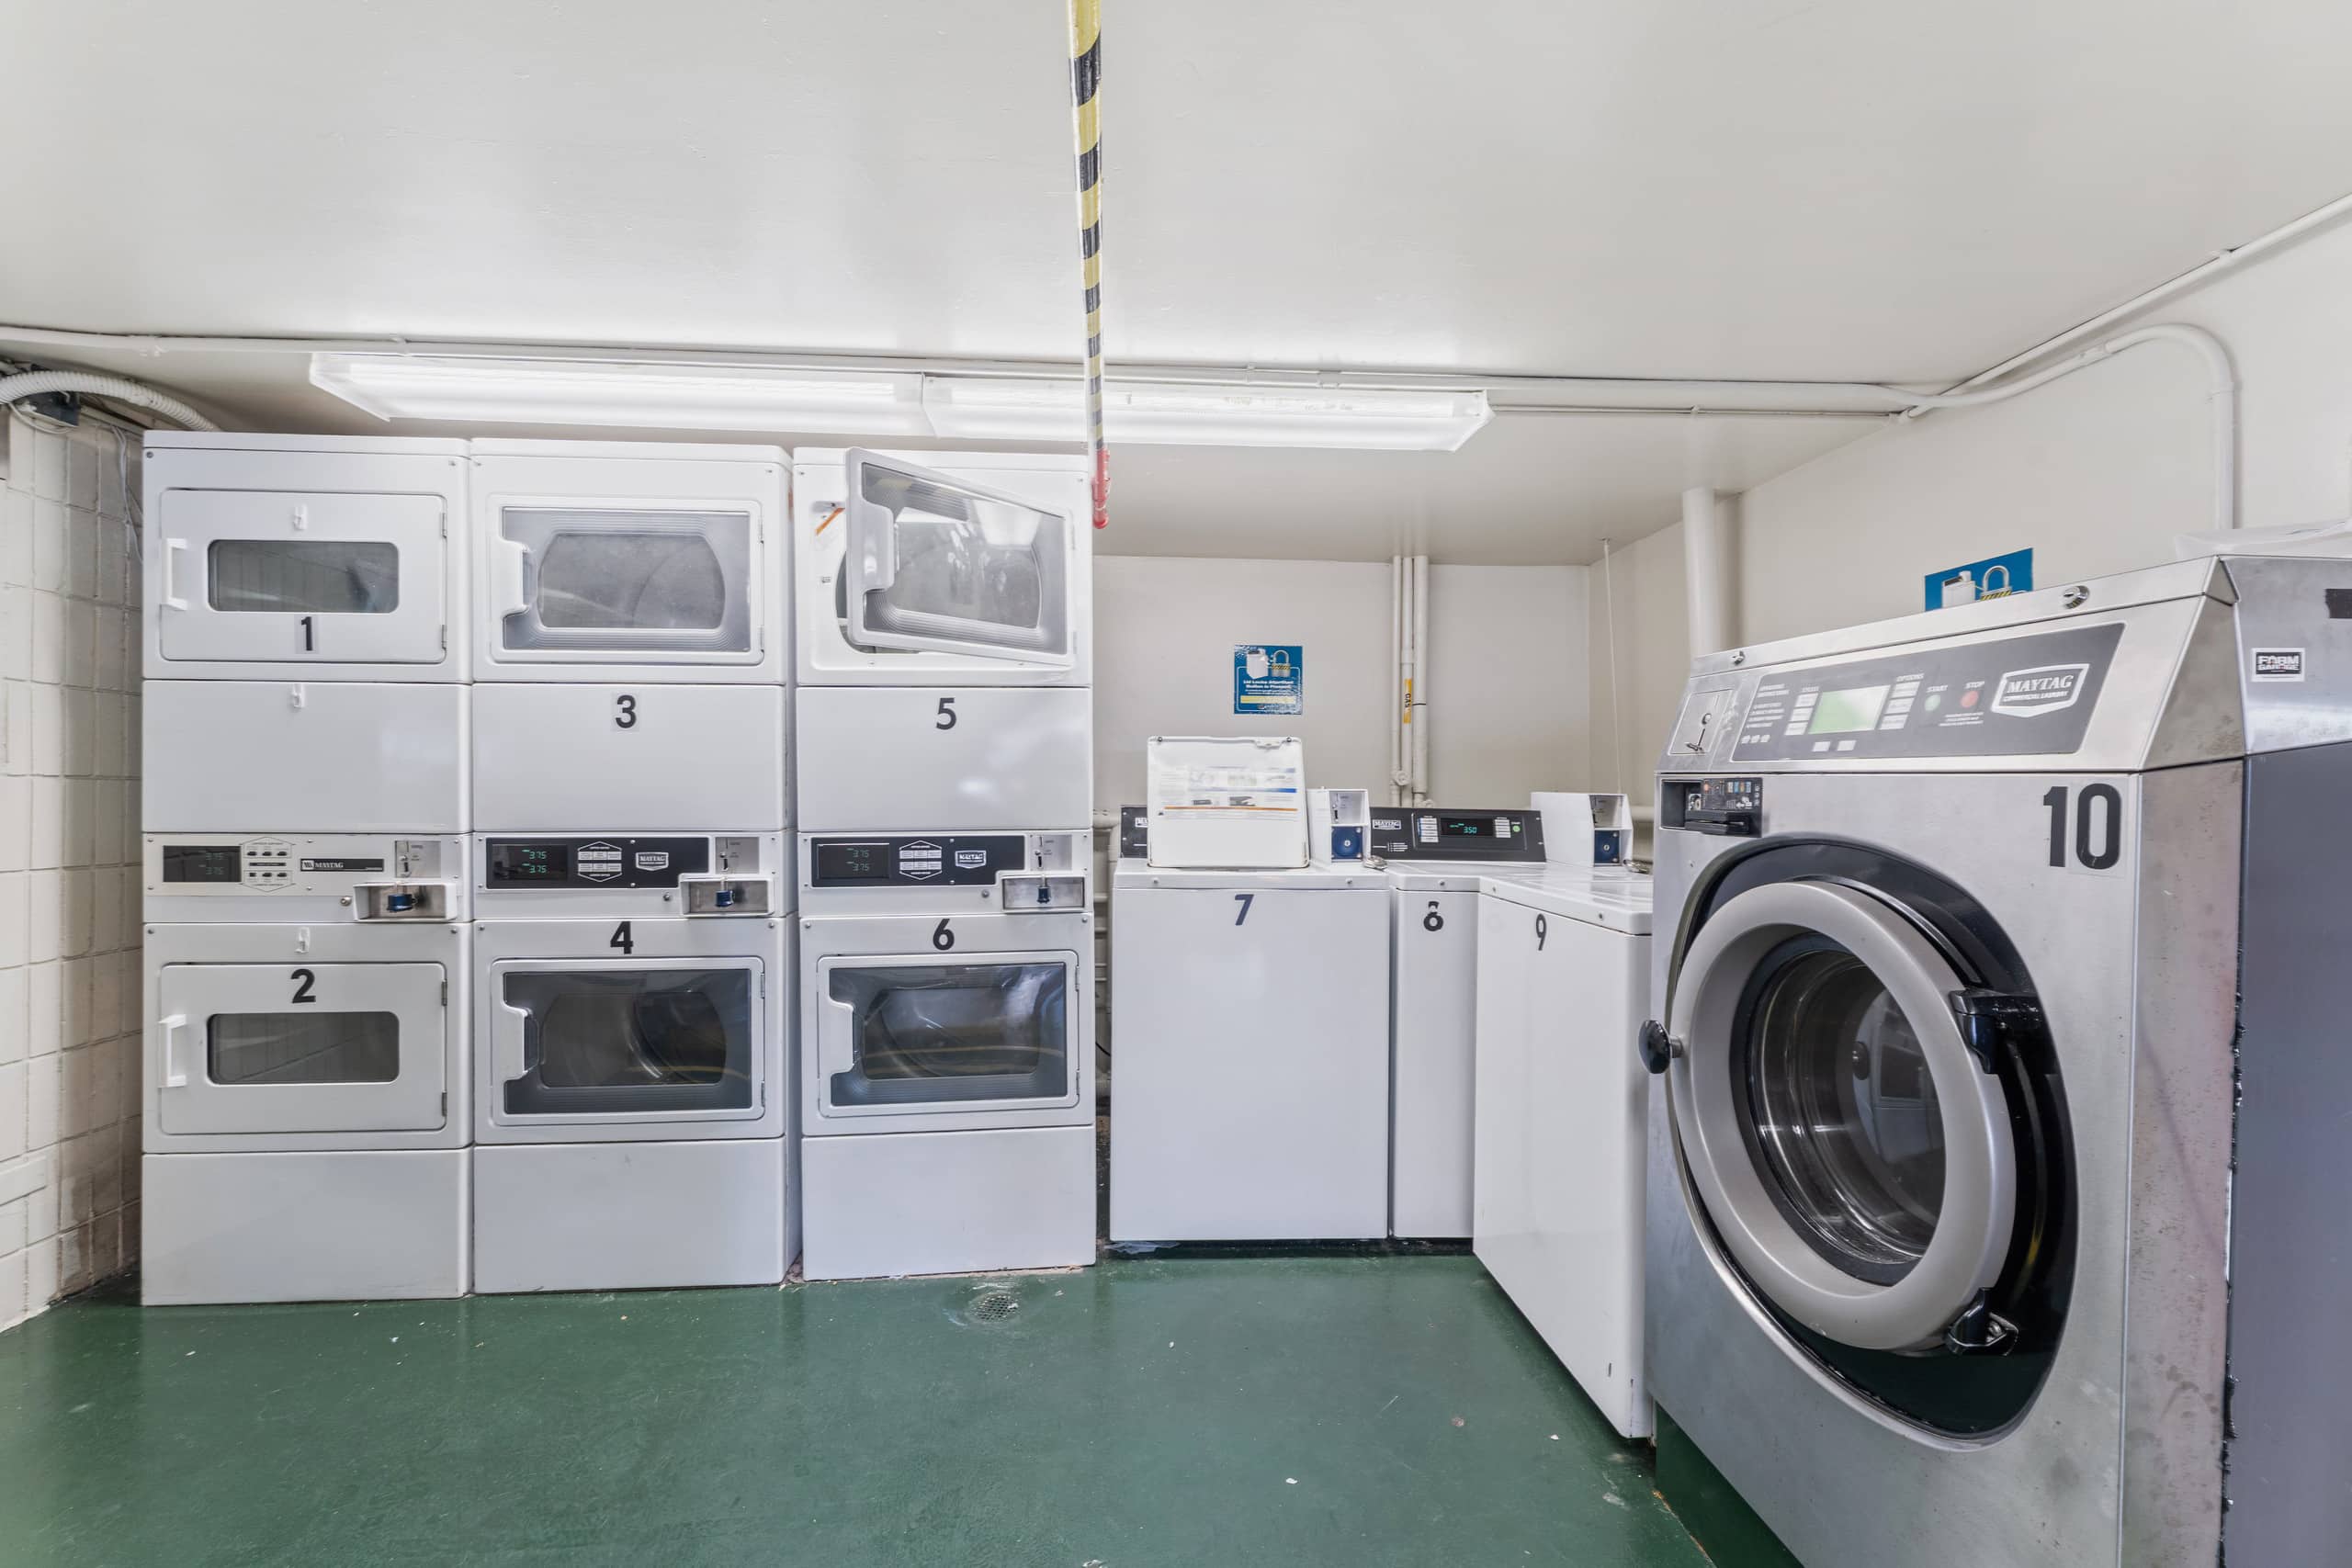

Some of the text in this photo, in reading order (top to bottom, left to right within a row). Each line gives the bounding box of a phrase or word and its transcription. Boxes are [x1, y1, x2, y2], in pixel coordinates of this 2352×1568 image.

[300, 616, 313, 651] 1
[1927, 684, 1948, 693] START
[1965, 681, 1985, 689] STOP
[2007, 674, 2075, 694] MAYTAG
[616, 694, 637, 728] 3
[936, 697, 957, 729] 5
[2042, 783, 2122, 870] 10
[1234, 894, 1255, 926] 7
[610, 920, 634, 954] 4
[933, 919, 955, 950] 6
[1535, 913, 1547, 951] 9
[290, 968, 316, 1003] 2
